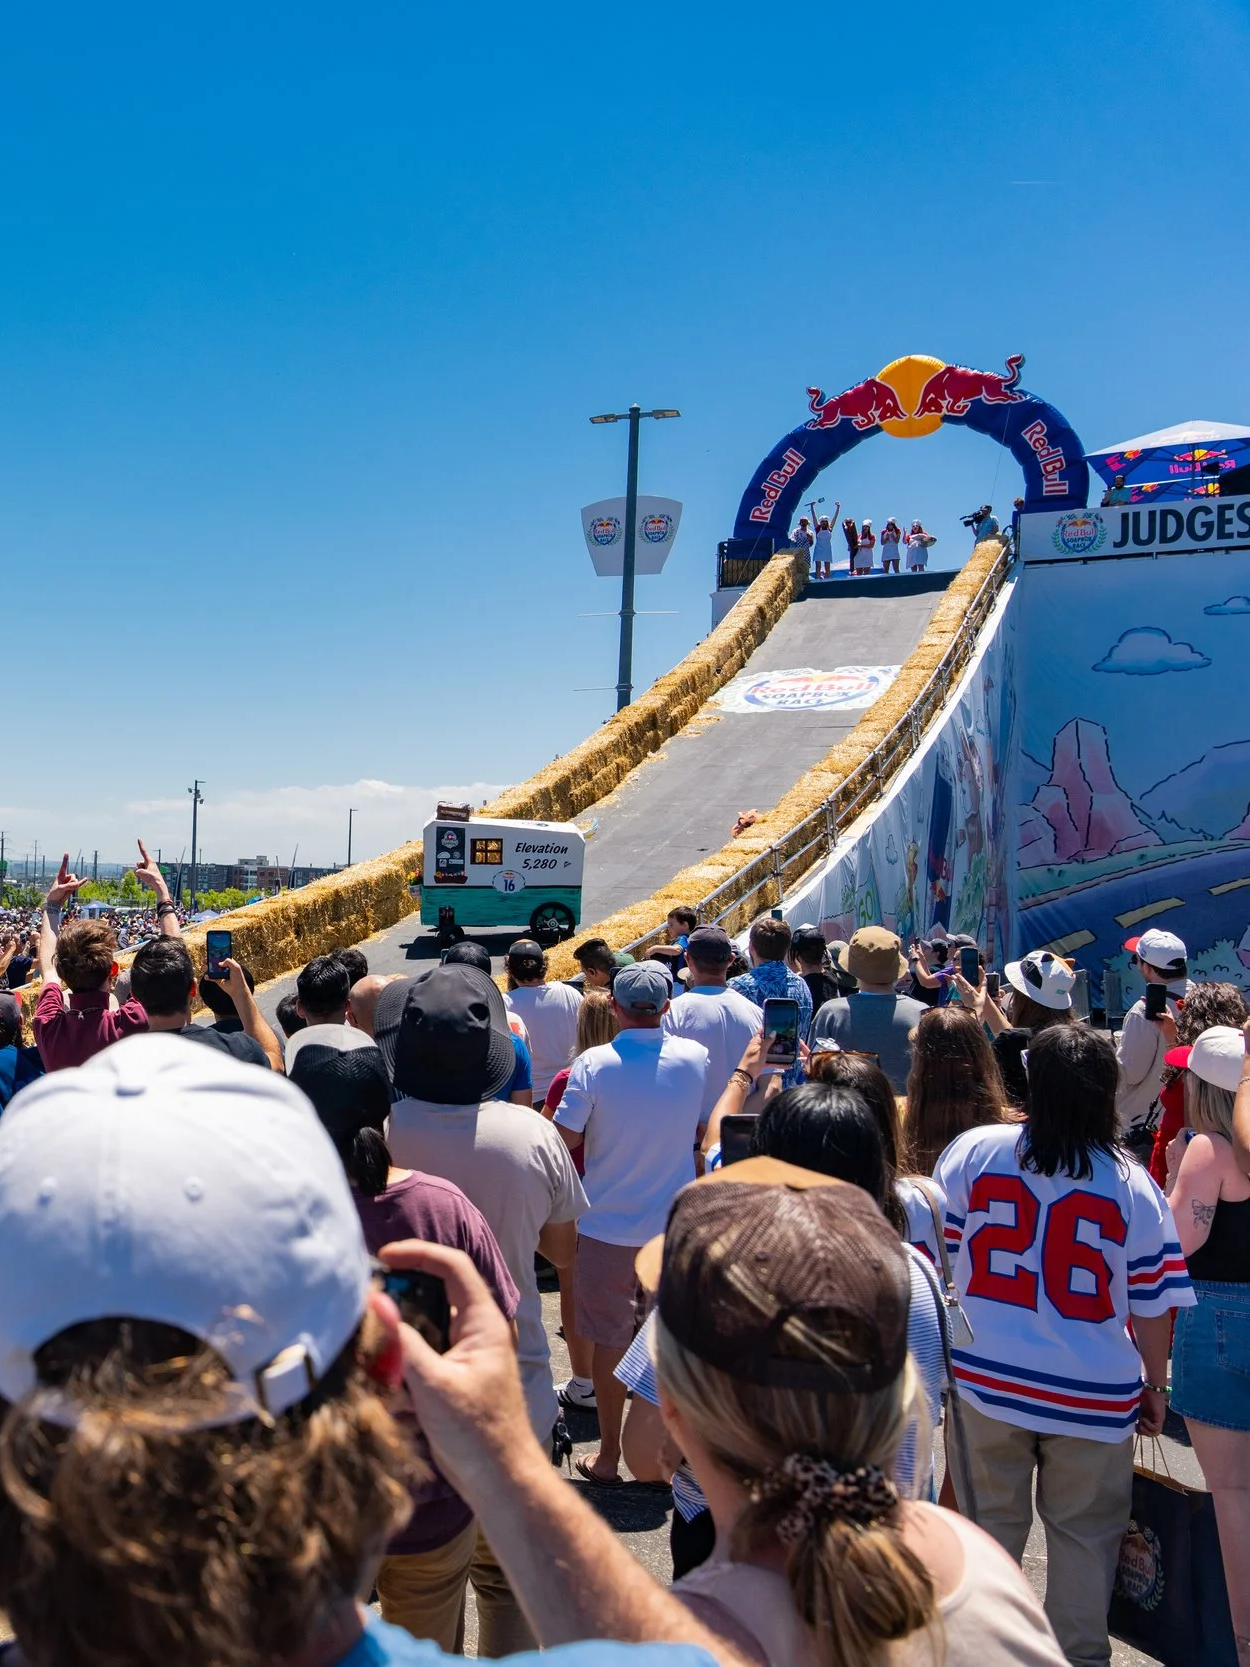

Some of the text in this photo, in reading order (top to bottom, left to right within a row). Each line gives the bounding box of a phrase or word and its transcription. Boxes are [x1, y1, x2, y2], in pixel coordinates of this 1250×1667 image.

[1021, 419, 1068, 496] Red Bull
[749, 447, 806, 523] Red Bull
[1113, 501, 1250, 548] JUDGES
[1063, 527, 1097, 538] Red Bull
[1066, 536, 1093, 544] SOAPBOX
[751, 682, 873, 694] Red Bull
[762, 691, 852, 699] SOAPBOX
[515, 842, 569, 855] Elevation
[522, 859, 558, 870] 5,280
[503, 879, 515, 892] 16
[966, 1172, 1128, 1324] 26
